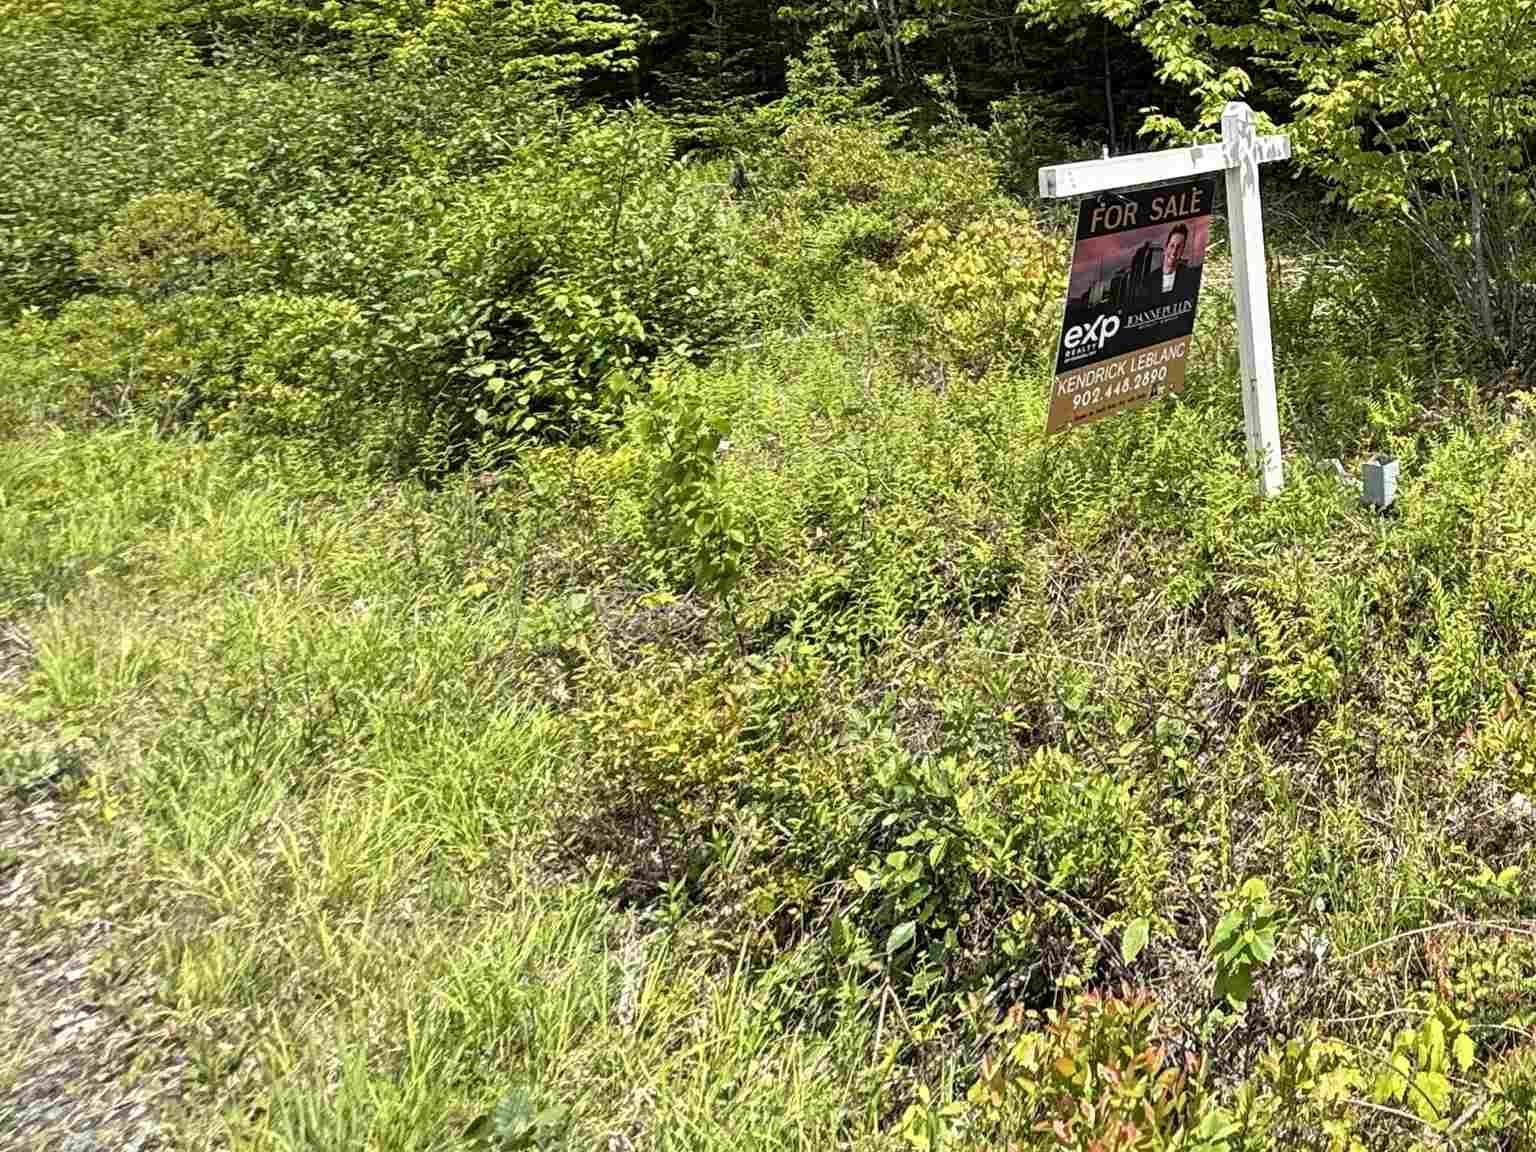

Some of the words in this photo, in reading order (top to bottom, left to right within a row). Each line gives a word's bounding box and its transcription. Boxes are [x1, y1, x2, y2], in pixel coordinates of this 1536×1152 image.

[1091, 202, 1137, 233] FOR
[1150, 191, 1202, 221] SALE
[1057, 359, 1127, 395] KENDRICK
[1131, 342, 1185, 373] LEBLANC
